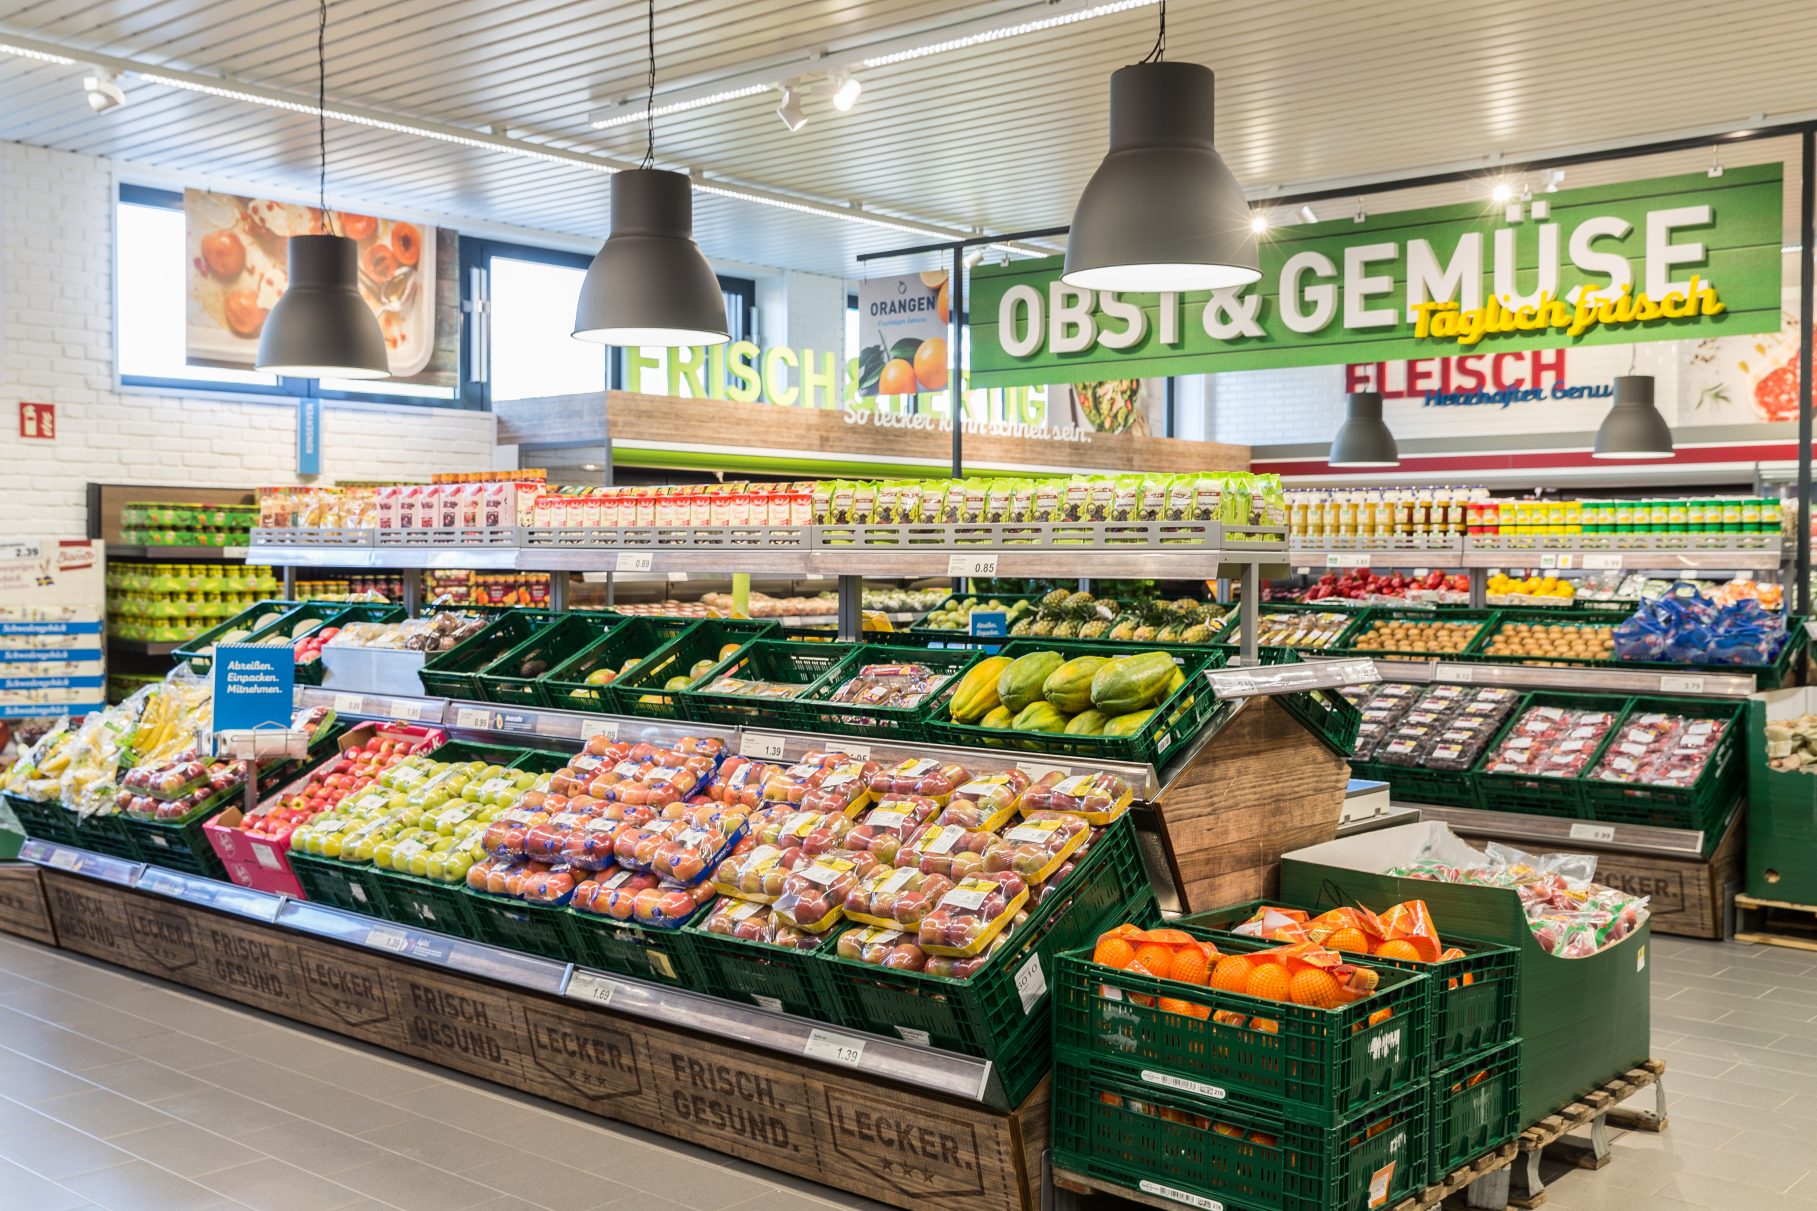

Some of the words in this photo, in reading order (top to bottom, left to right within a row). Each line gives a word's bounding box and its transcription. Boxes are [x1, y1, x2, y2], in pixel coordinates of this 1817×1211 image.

[999, 280, 1181, 357] OBST
[1202, 288, 1268, 341] &
[1279, 201, 1711, 334] GEMÜSE
[870, 296, 936, 316] ORANGEN
[1411, 290, 1571, 345] Täglich
[1567, 275, 1725, 337] frisch
[627, 340, 836, 410] FRISCH
[1345, 348, 1567, 400] FLEISCH
[1551, 379, 1614, 401] Genu
[843, 406, 870, 425] So
[938, 412, 987, 434] knn
[635, 559, 650, 569] 0.89
[974, 562, 995, 573] 0.85
[226, 672, 280, 684] Einpacken.
[227, 660, 275, 671] Abreißen.
[226, 683, 283, 695] Mitnehmen.
[765, 745, 781, 756] 1.39
[210, 930, 280, 968] FRISCH.
[215, 958, 288, 998] GESUND.
[305, 960, 383, 1003] LECKER.
[592, 987, 611, 1000] 1.69
[410, 982, 498, 1030] FRISCH.
[413, 1015, 513, 1066] GESUND.
[533, 1023, 634, 1075] LECKER.
[837, 1047, 858, 1062] 1.39
[670, 1052, 786, 1111] FRISCH.
[672, 1089, 800, 1153] GESUND.
[836, 1104, 973, 1171] LECKER.
